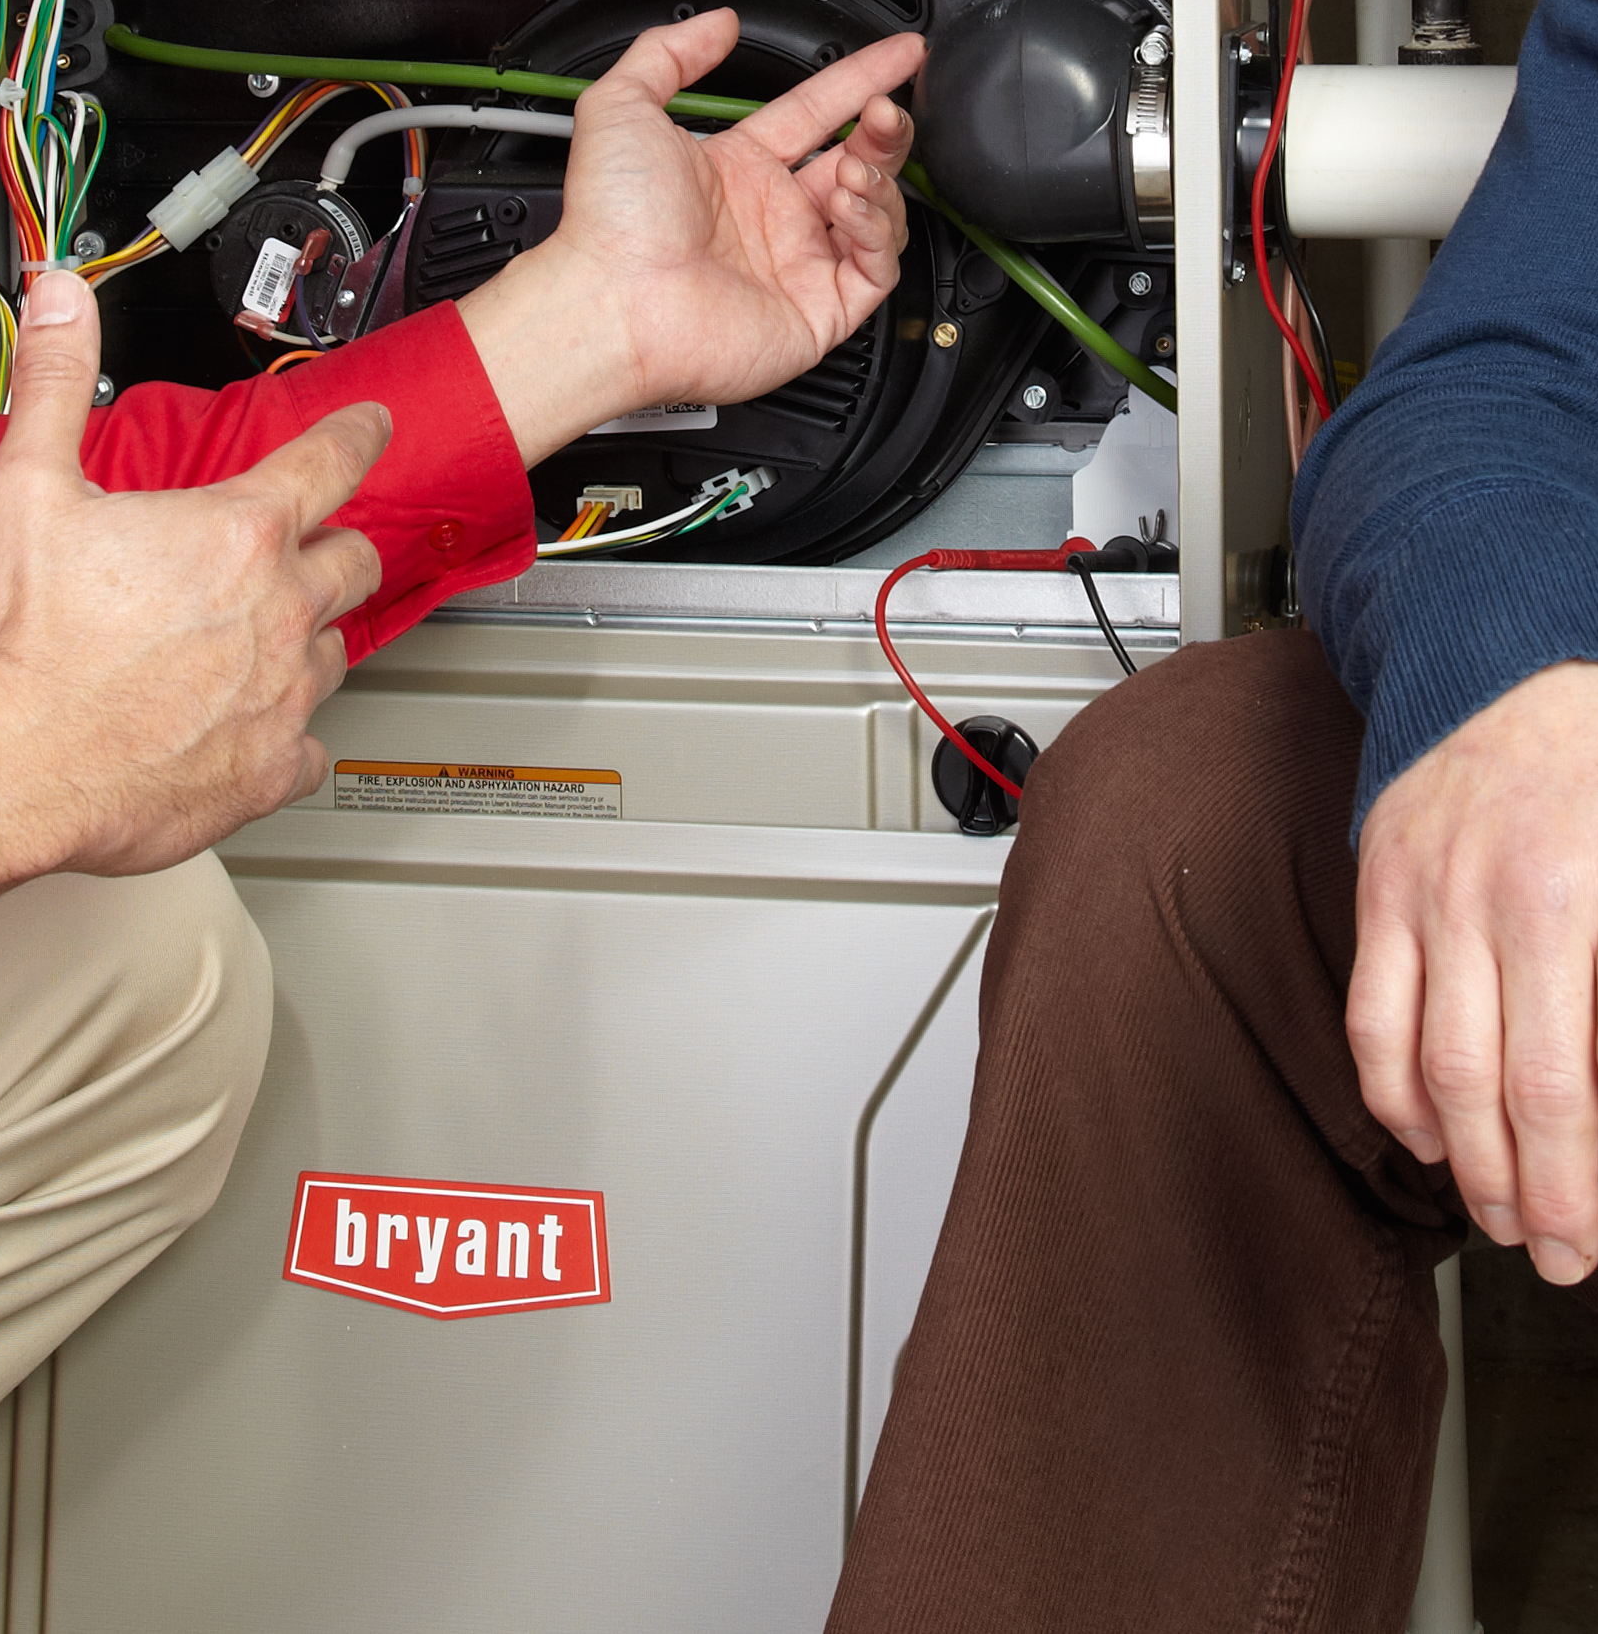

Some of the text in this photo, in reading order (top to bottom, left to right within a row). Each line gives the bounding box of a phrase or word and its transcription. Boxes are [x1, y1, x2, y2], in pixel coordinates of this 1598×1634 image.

[457, 767, 515, 779] WARNING
[358, 775, 585, 794] FIRE, EXPLOSION AND ASPHYXIATION HAZARD
[334, 1198, 564, 1284] bryant
